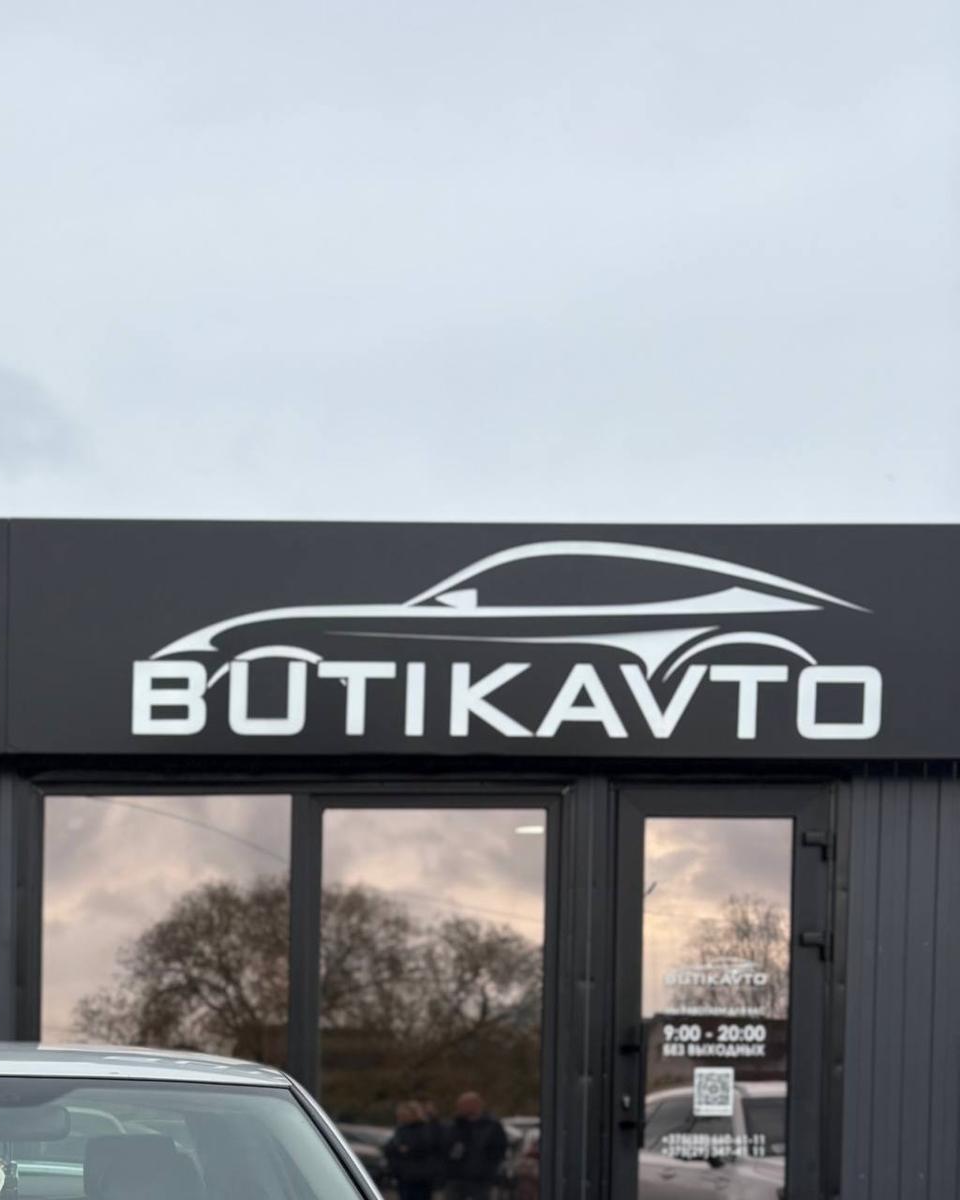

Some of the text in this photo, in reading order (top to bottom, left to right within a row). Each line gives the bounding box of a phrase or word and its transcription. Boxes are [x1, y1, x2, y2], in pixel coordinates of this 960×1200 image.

[131, 660, 883, 740] BUTIKAVTO
[663, 1024, 702, 1042] 9:00
[717, 1024, 766, 1042] 20:00
